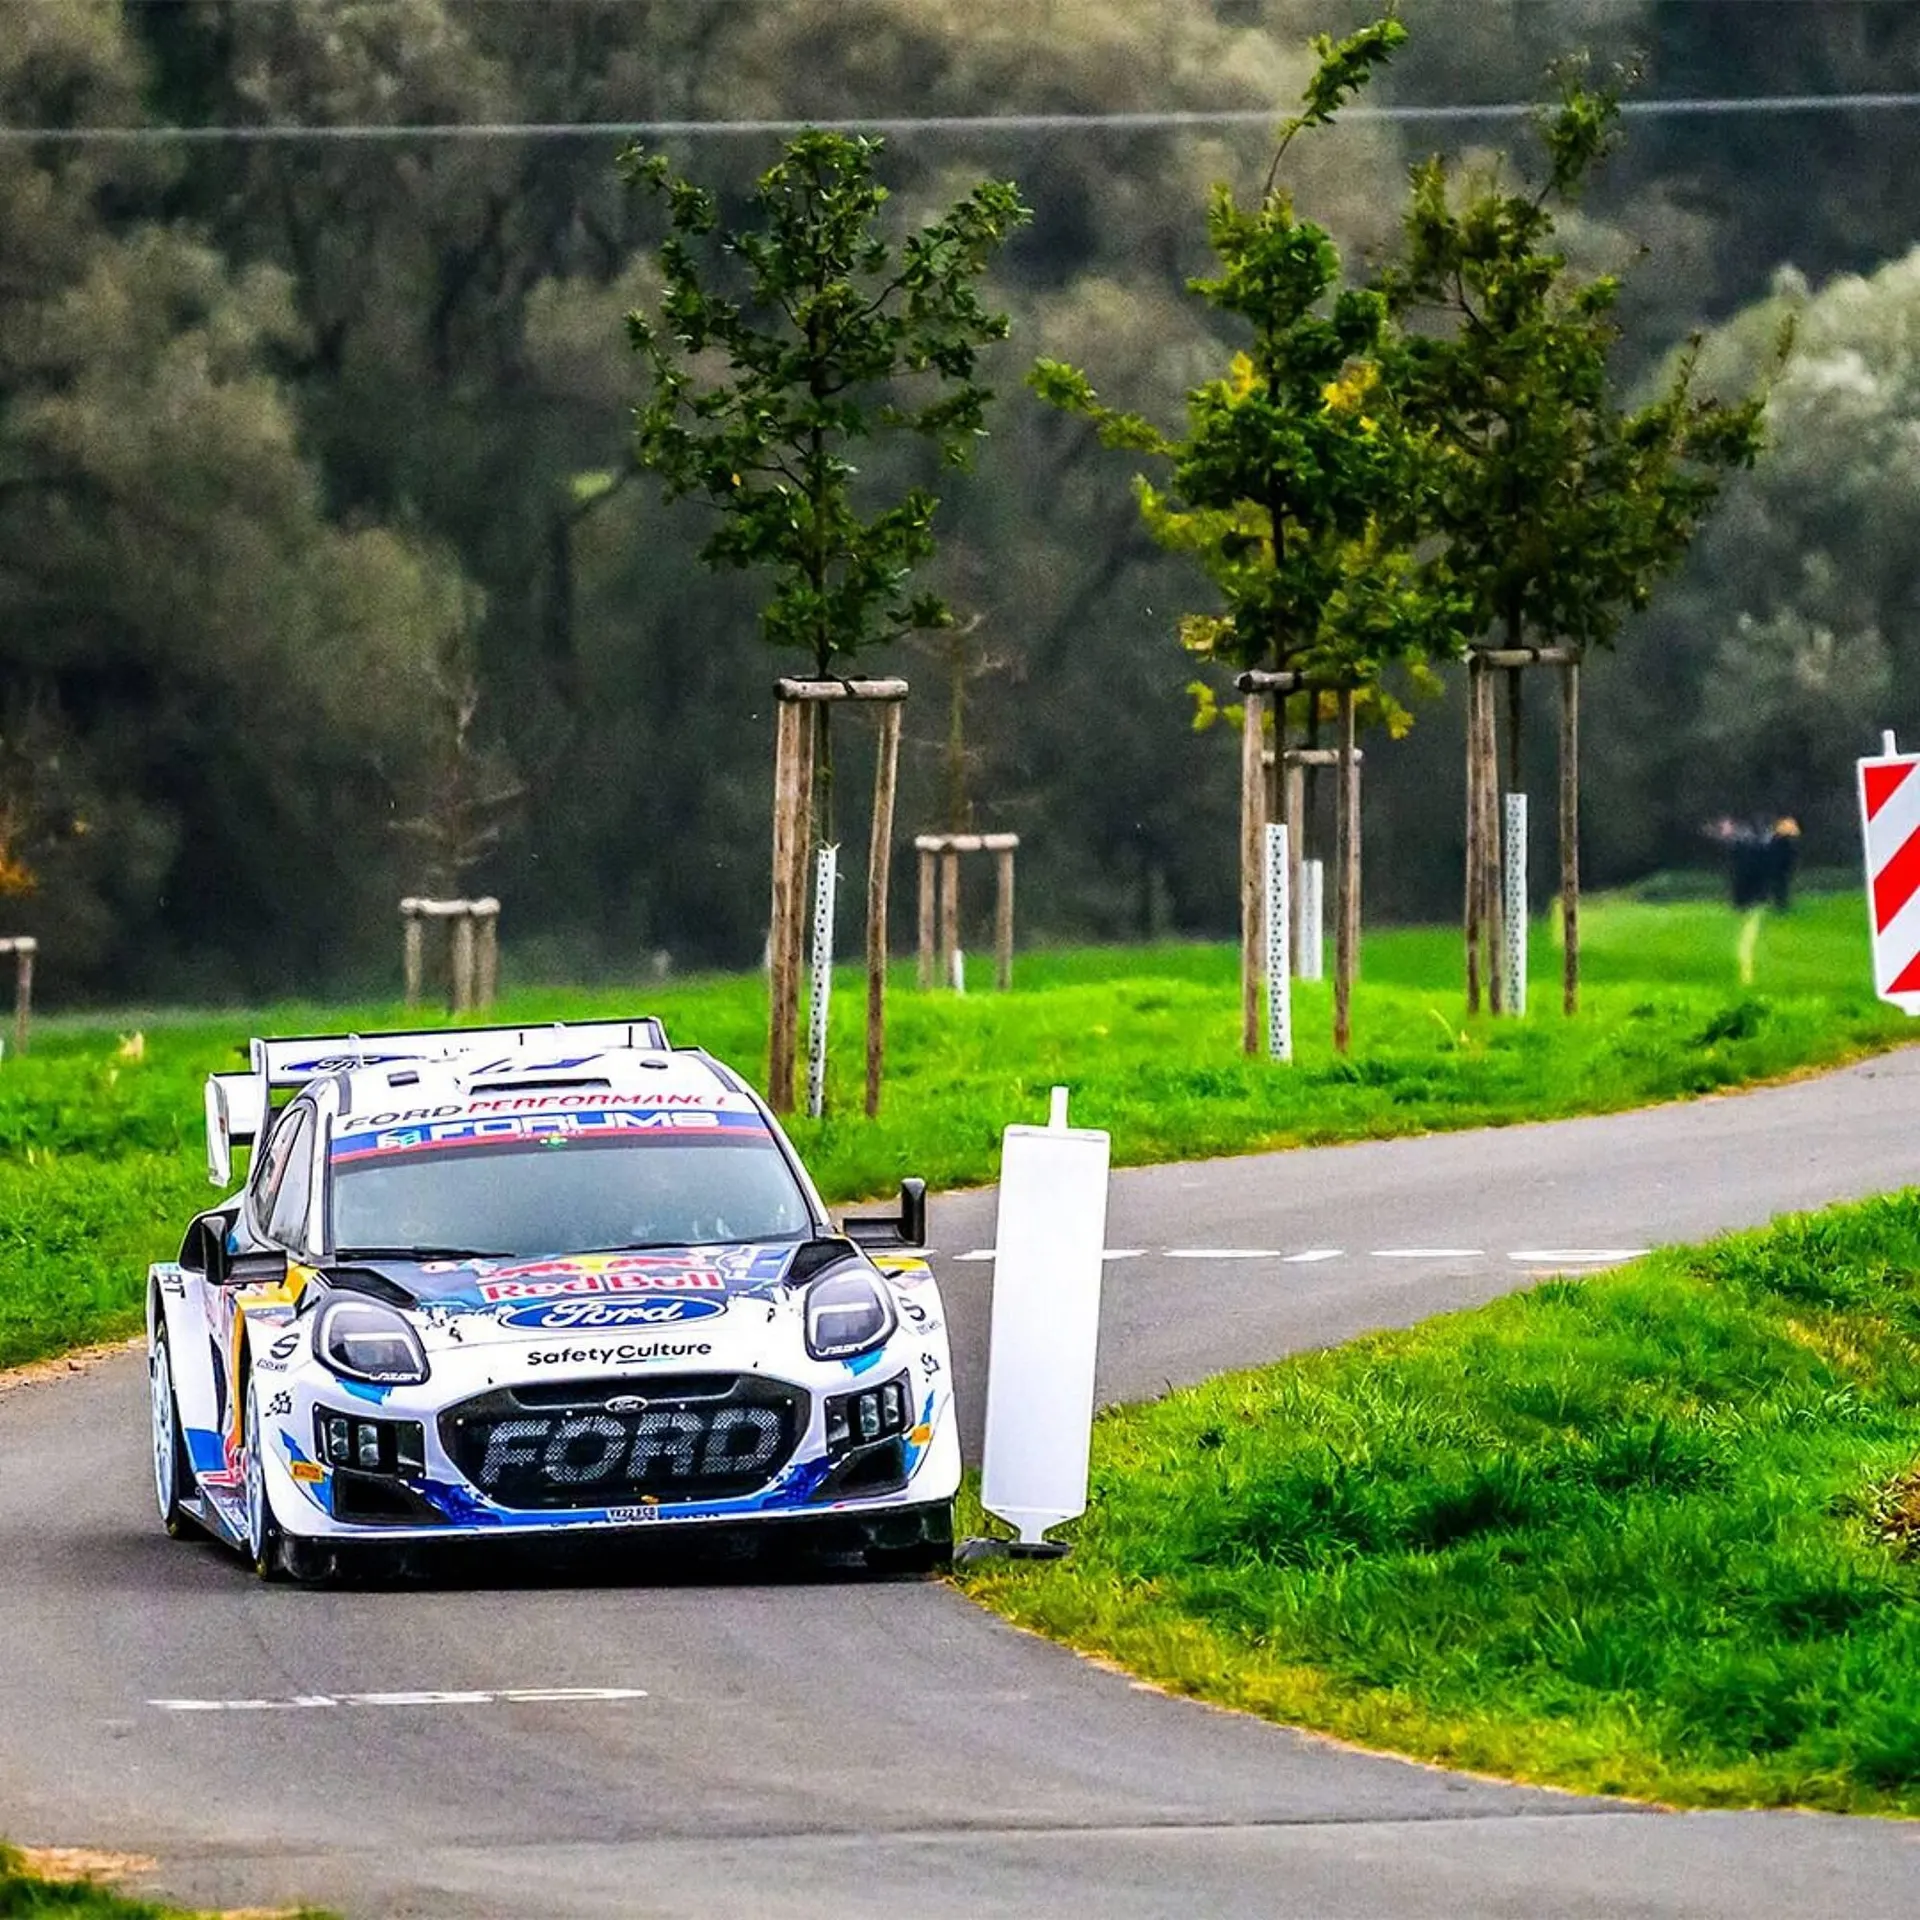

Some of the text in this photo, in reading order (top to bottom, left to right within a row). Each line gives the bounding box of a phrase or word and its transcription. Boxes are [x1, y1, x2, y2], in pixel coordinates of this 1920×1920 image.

[344, 1105, 463, 1131] FORD
[486, 1272, 722, 1300] Red Bull
[541, 1299, 684, 1327] Ford
[527, 1342, 712, 1367] SafetyCulture
[480, 1408, 782, 1485] FORD
